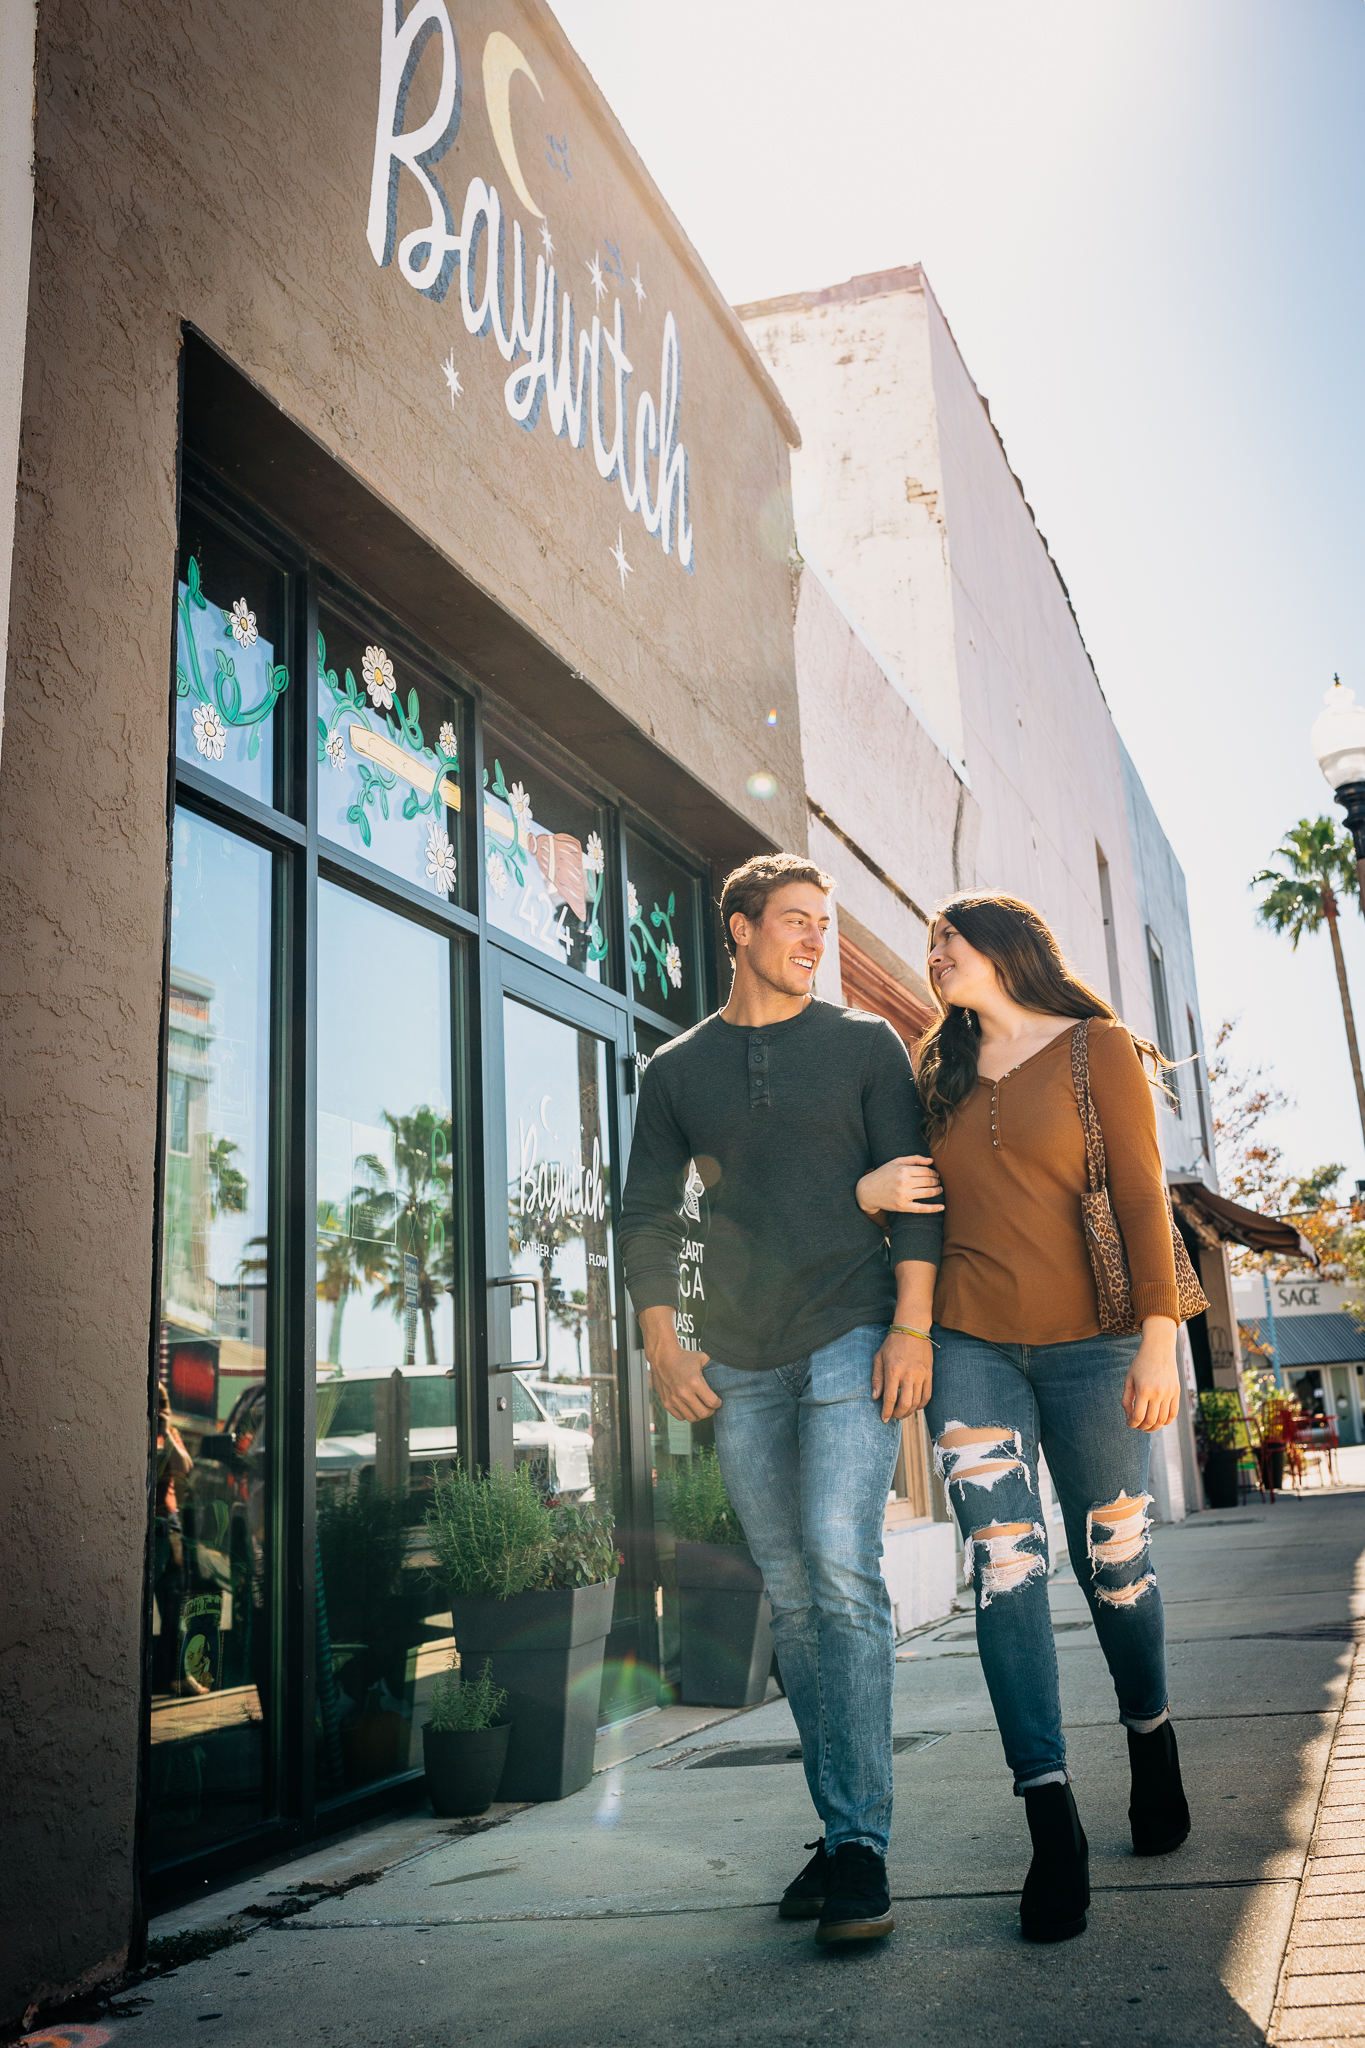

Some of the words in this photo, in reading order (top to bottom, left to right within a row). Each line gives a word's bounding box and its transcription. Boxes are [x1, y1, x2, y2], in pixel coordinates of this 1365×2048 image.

[367, 0, 694, 573] Baywitch
[518, 885, 574, 956] 424
[519, 1117, 605, 1223] Baywitch
[588, 1253, 608, 1268] FLOW
[679, 1238, 705, 1264] EART
[679, 1263, 705, 1301] GA
[1278, 1286, 1321, 1308] SAGE
